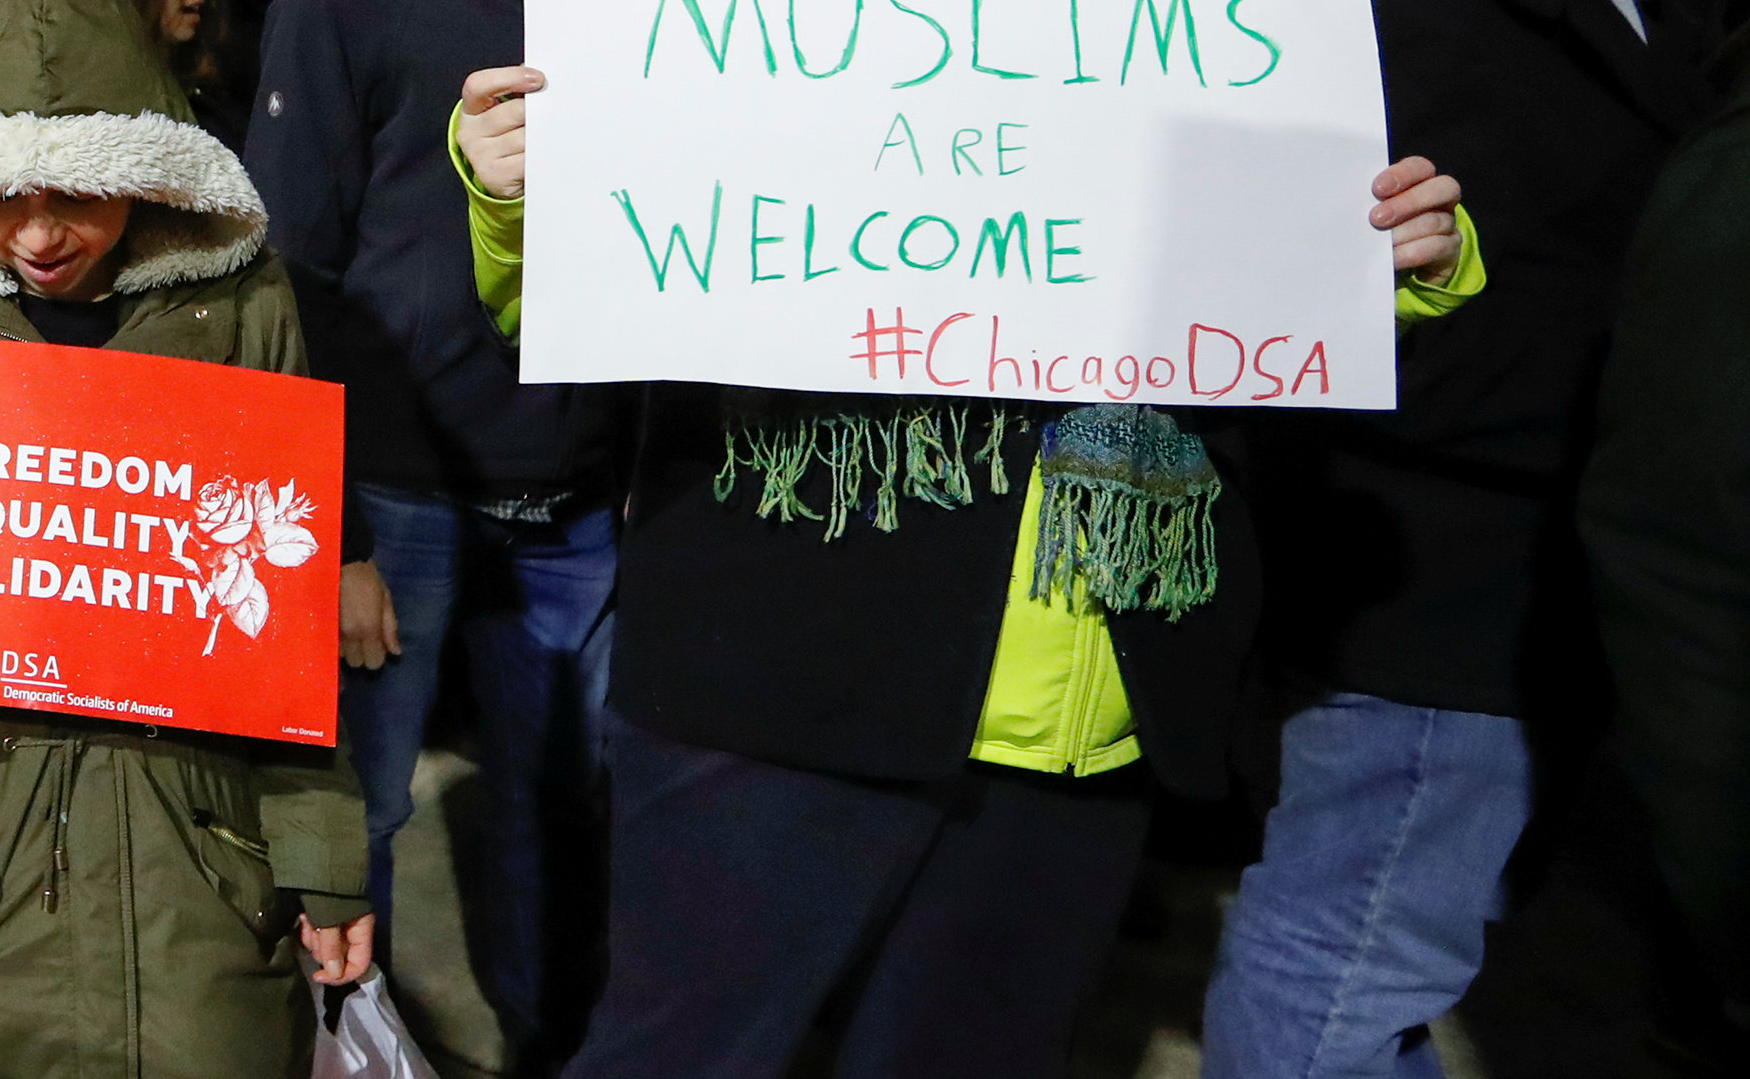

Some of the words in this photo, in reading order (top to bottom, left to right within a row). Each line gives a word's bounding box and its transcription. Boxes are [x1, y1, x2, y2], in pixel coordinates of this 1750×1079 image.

[874, 113, 1029, 177] ARE
[611, 180, 1097, 293] WELCOME
[851, 307, 1330, 401] #ChicagoDSA
[1, 650, 60, 680] DSA
[3, 685, 65, 705] Democratic
[66, 692, 116, 711] Socialists
[116, 699, 130, 713] of
[130, 701, 174, 718] America
